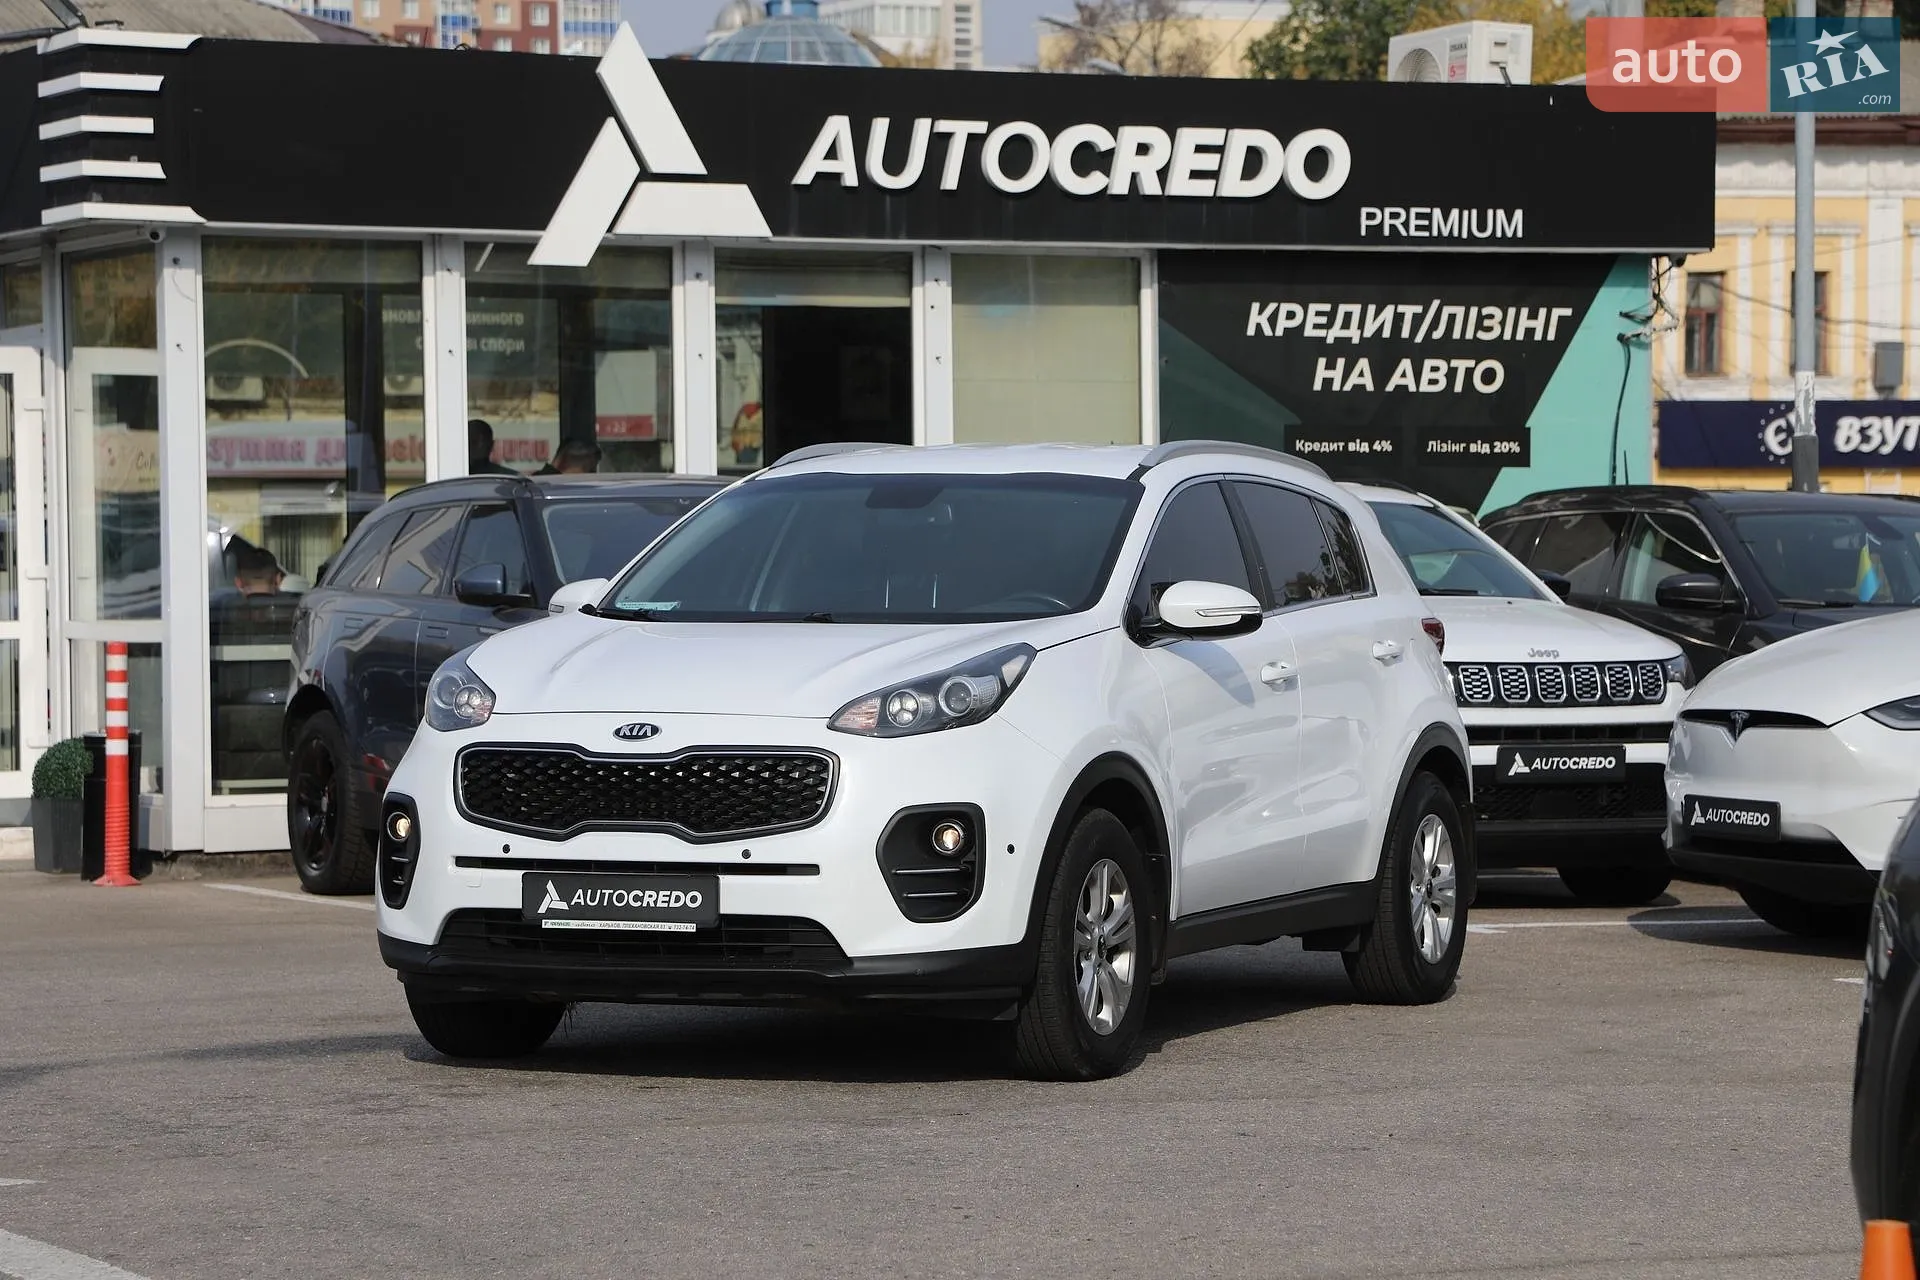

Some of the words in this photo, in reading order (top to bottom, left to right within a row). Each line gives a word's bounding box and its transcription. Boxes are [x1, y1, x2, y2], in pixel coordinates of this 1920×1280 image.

[791, 115, 1351, 200] AUTOCREDO
[1360, 206, 1524, 239] PREMIUM
[1246, 299, 1573, 344] КРЕДИТ/ЛІЗІНГ
[1312, 357, 1374, 391] НА
[1384, 357, 1505, 394] АВТО
[1295, 439, 1344, 453] Кредит
[1348, 438, 1369, 454] від
[1372, 439, 1393, 452] 4%
[1427, 440, 1467, 453] Лізінг
[1469, 440, 1491, 454] від
[1493, 441, 1521, 454] 20%
[1527, 647, 1560, 659] Jeep
[619, 724, 652, 737] KIA
[1530, 756, 1616, 770] AUTOCREDO
[1705, 807, 1771, 827] AUTOCREDO
[570, 888, 703, 909] AUTOCREDO
